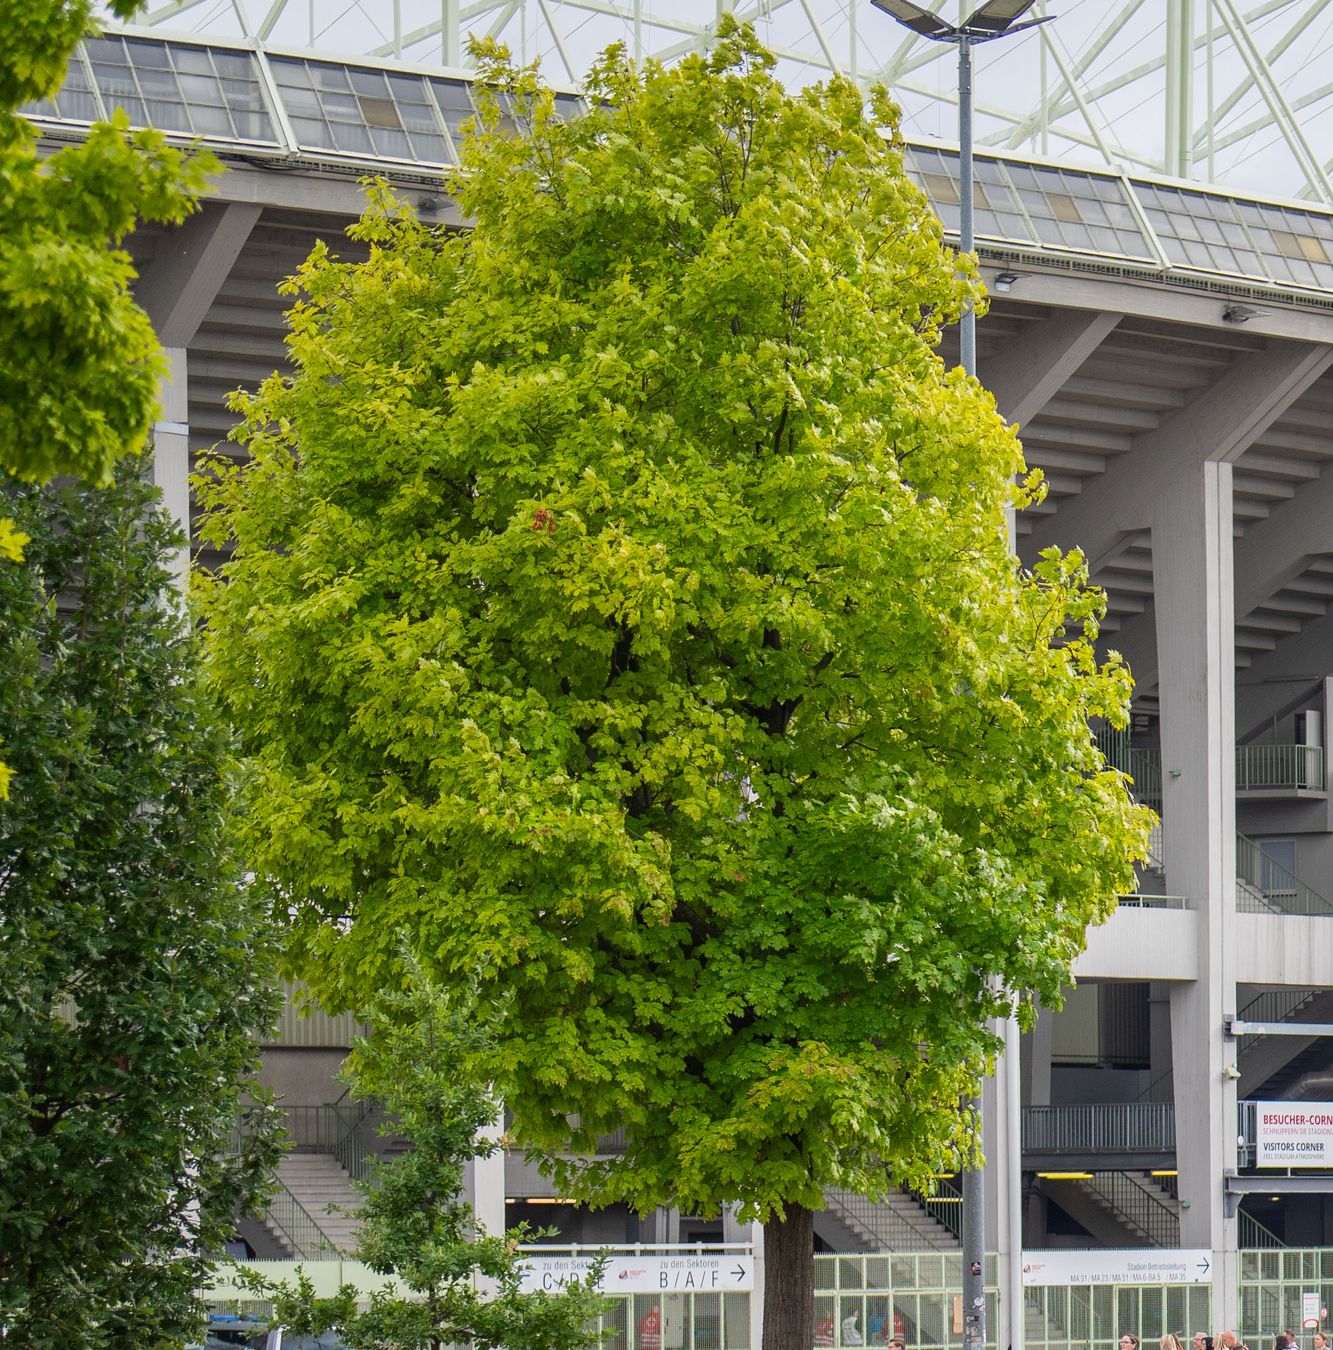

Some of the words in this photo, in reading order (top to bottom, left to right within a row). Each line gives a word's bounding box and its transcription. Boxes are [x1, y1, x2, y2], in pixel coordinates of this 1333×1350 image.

[1263, 1143, 1294, 1151] VISITORS
[1296, 1143, 1324, 1151] CORNER
[554, 1260, 568, 1269] den
[660, 1261, 669, 1269] zu
[670, 1259, 685, 1269] den
[687, 1259, 719, 1269] Sektoren
[1127, 1263, 1147, 1271] Stadion
[543, 1272, 552, 1290] C
[659, 1271, 668, 1288] B
[685, 1271, 695, 1287] A
[712, 1270, 719, 1287] F
